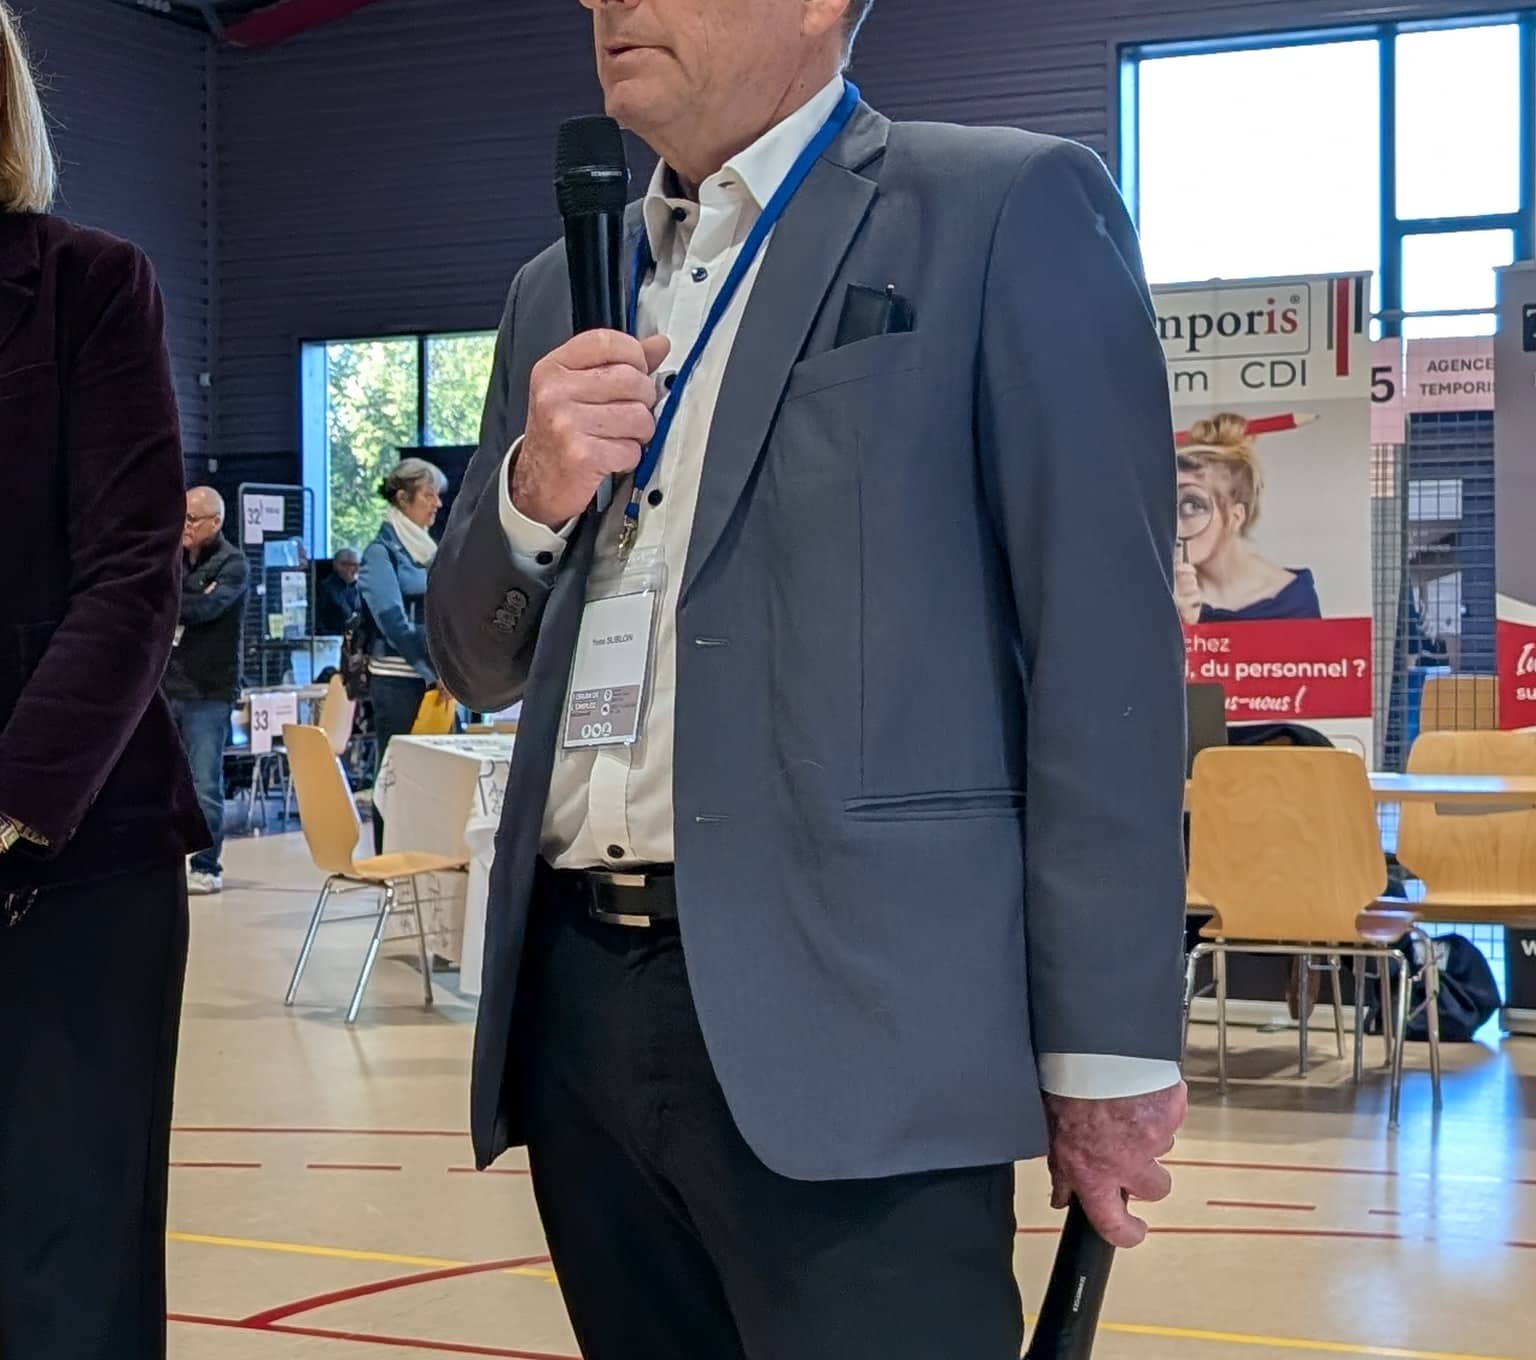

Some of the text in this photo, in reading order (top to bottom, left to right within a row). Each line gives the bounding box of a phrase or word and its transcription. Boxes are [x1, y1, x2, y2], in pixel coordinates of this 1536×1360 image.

[1240, 359, 1306, 389] CDI
[1427, 357, 1496, 373] AGENCE
[1420, 380, 1495, 397] TEMPORI
[1200, 658, 1230, 678] du
[1235, 658, 1348, 681] personnel
[253, 709, 269, 732] 33
